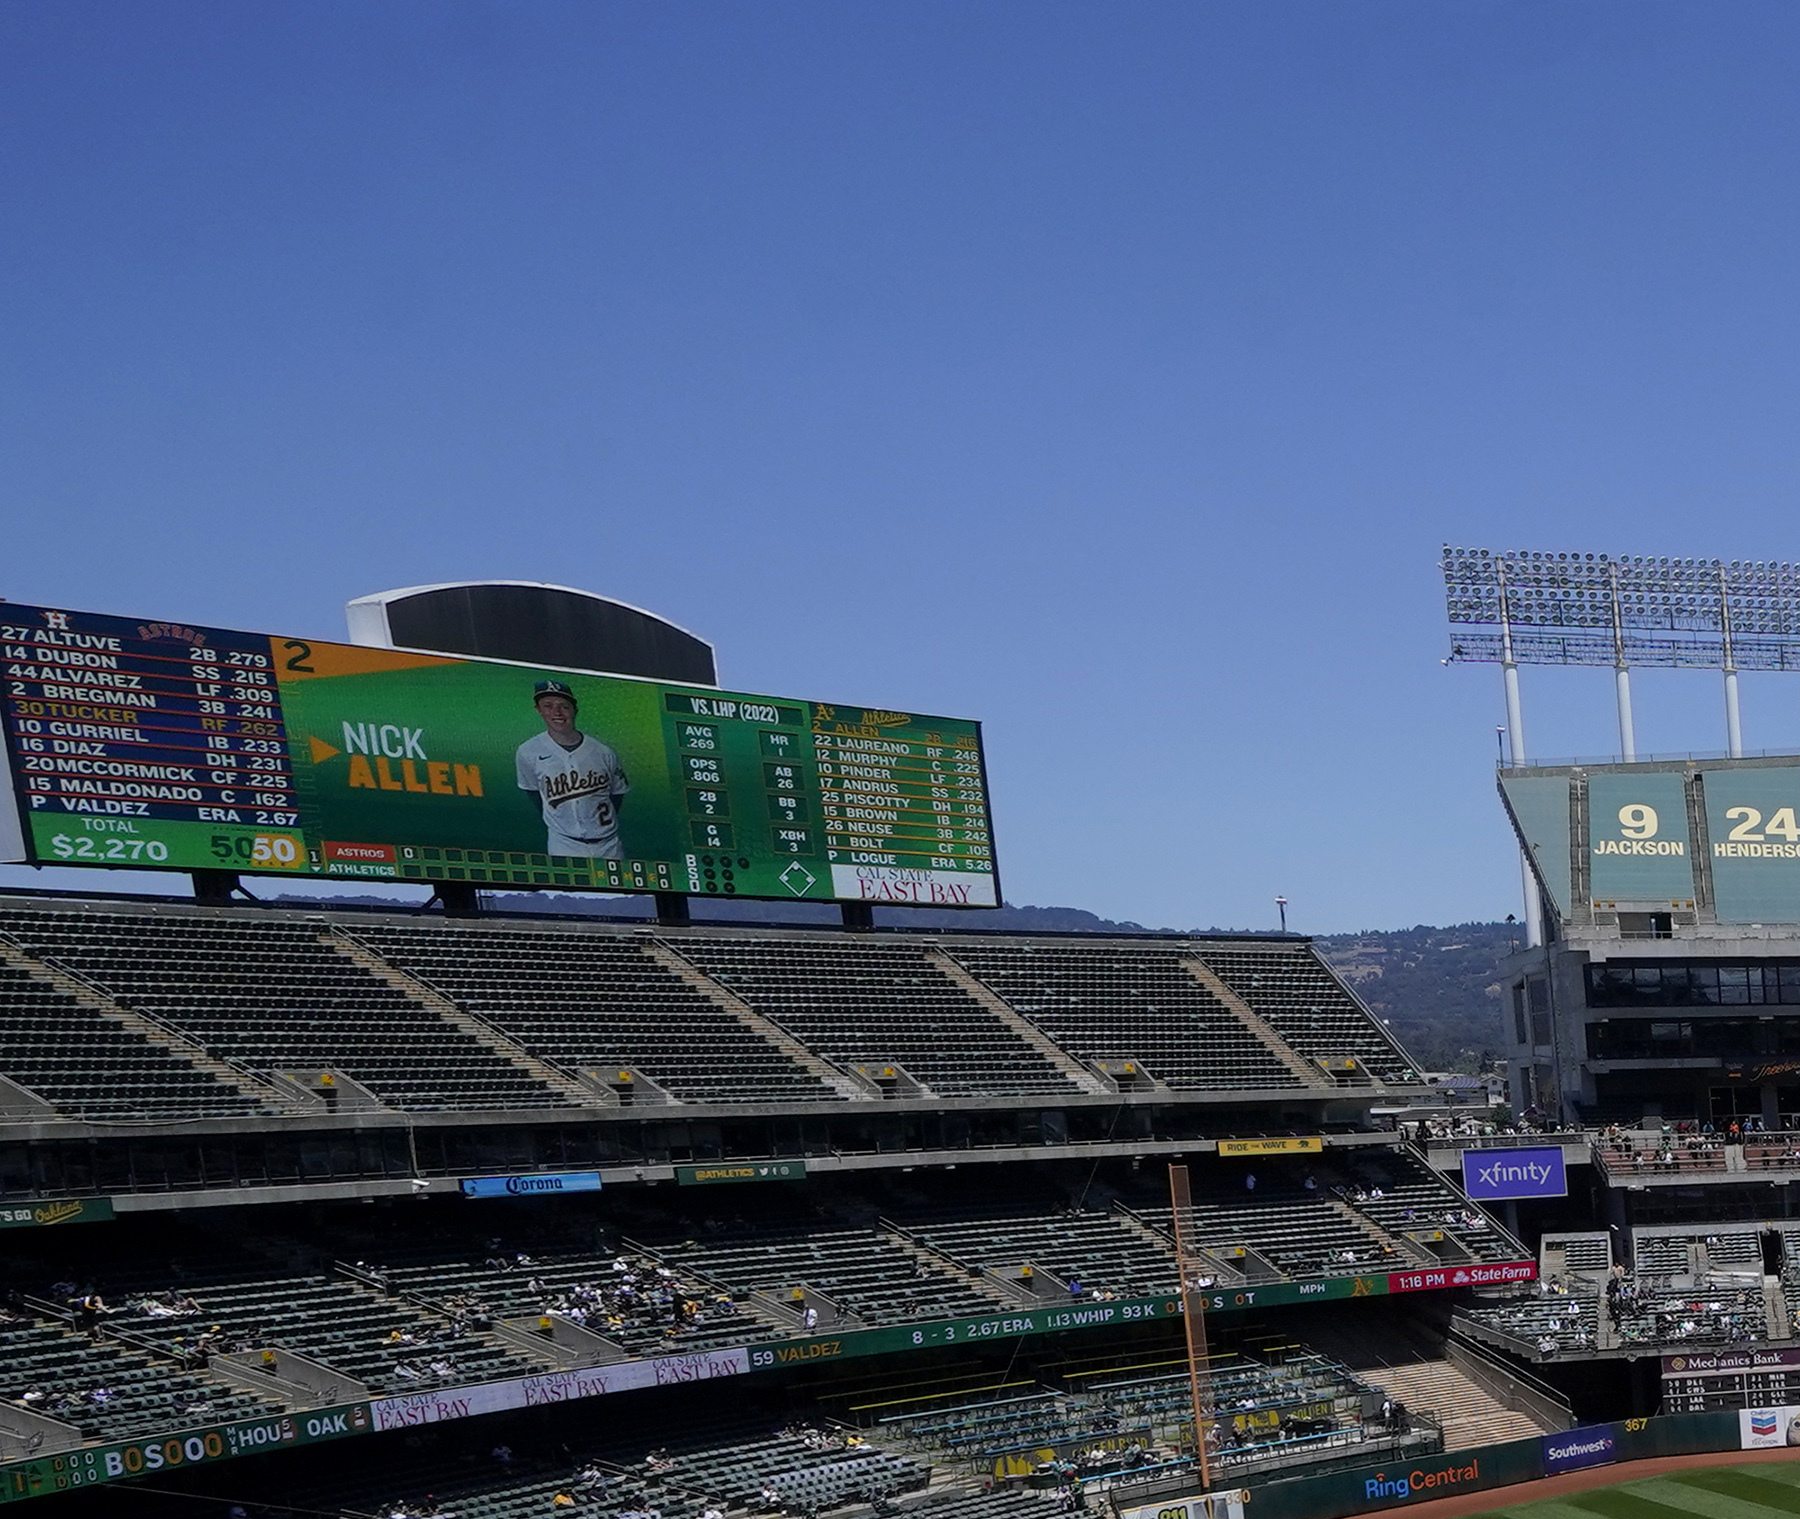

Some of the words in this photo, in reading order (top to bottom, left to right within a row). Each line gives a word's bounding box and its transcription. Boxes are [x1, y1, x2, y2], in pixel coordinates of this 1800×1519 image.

[1, 626, 29, 641] 27
[33, 629, 122, 651] ALTUVE
[37, 648, 117, 669] DUBON
[40, 668, 143, 689] ALVAREZ
[43, 685, 156, 708] BREGMAN
[47, 704, 139, 724] TUCKER
[50, 722, 149, 743] GURRIEL
[342, 721, 427, 760] NICK
[53, 740, 107, 756] DIAZ
[57, 759, 196, 782] MCCORMICK
[349, 755, 484, 797] ALLEN
[60, 779, 203, 801] MALDONADO
[61, 797, 150, 816] VALDEZ
[198, 807, 240, 823] ERA
[256, 811, 298, 826] 2.67
[1618, 804, 1659, 839] 9
[81, 818, 139, 834] TOTAL
[51, 834, 168, 862] $2,270
[336, 847, 384, 859] ASTROS
[1594, 840, 1684, 856] JACKSON
[329, 862, 395, 876] ATHLETICS
[859, 879, 922, 902] EAST
[929, 884, 972, 904] BAY
[1227, 1142, 1249, 1152] RIDE
[1261, 1141, 1287, 1150] WAVE
[506, 1174, 563, 1196] Corona
[1478, 1161, 1552, 1187] xfinity
[14, 1210, 32, 1221] GO
[1300, 1283, 1325, 1295] MPH
[1399, 1277, 1422, 1289] 1:16
[1426, 1274, 1445, 1286] PM
[967, 1321, 999, 1338] 2.67
[1002, 1317, 1034, 1333] ERA
[1047, 1313, 1070, 1327] 1.13
[1071, 1308, 1114, 1325] WHIP
[1122, 1305, 1143, 1319] 93
[1143, 1303, 1155, 1316] K
[752, 1351, 774, 1367] 59
[777, 1341, 841, 1363] VALDEZ
[1689, 1356, 1750, 1370] Mechanics
[1754, 1353, 1782, 1365] Bank
[378, 1405, 434, 1431] EAST
[438, 1398, 472, 1420] BAY
[1625, 1418, 1648, 1432] 367
[239, 1424, 281, 1447] HOU
[307, 1414, 348, 1436] OAK
[1549, 1438, 1605, 1461] Southwest
[1365, 1460, 1479, 1499] RingCentral
